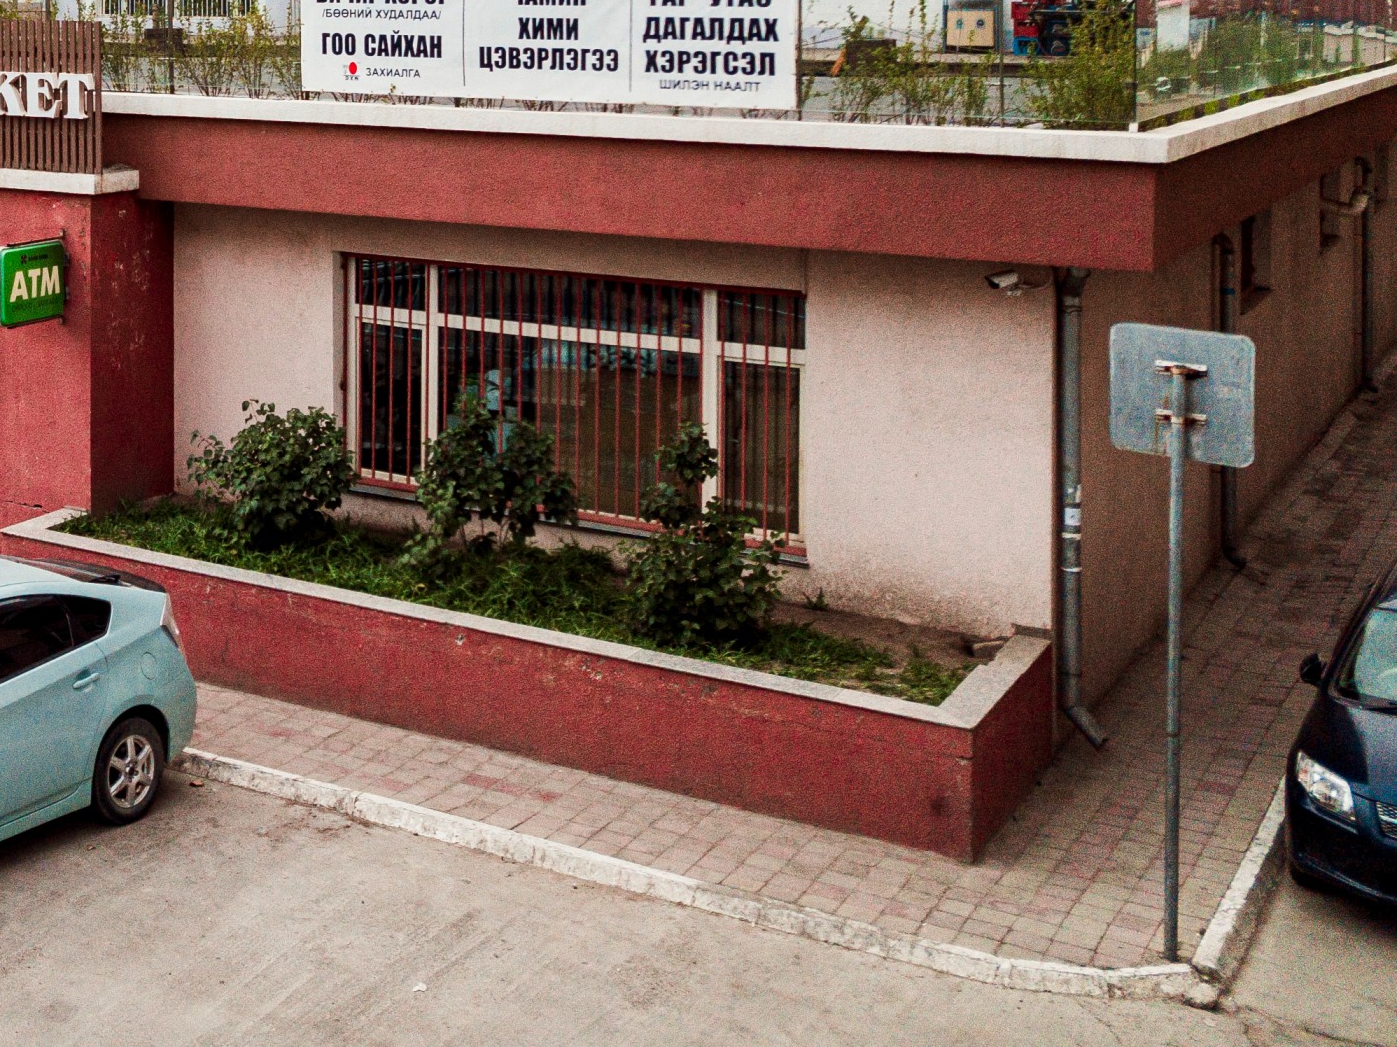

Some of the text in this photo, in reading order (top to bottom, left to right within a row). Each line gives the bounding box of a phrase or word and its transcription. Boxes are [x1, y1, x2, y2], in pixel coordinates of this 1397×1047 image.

[518, 17, 579, 40] ХИМИ
[642, 16, 779, 45] ДАГАЛДАХ
[322, 30, 442, 58] ГОО САЙХАН
[479, 46, 619, 72] ЦЭВЭРЛЭГЭЭ
[645, 50, 776, 76] ХЭРЭГСЭЛ
[366, 68, 420, 78] ЗАХИАЛГА
[659, 80, 761, 92] ШИЛЭН НААЛТ
[9, 265, 61, 303] ATM
